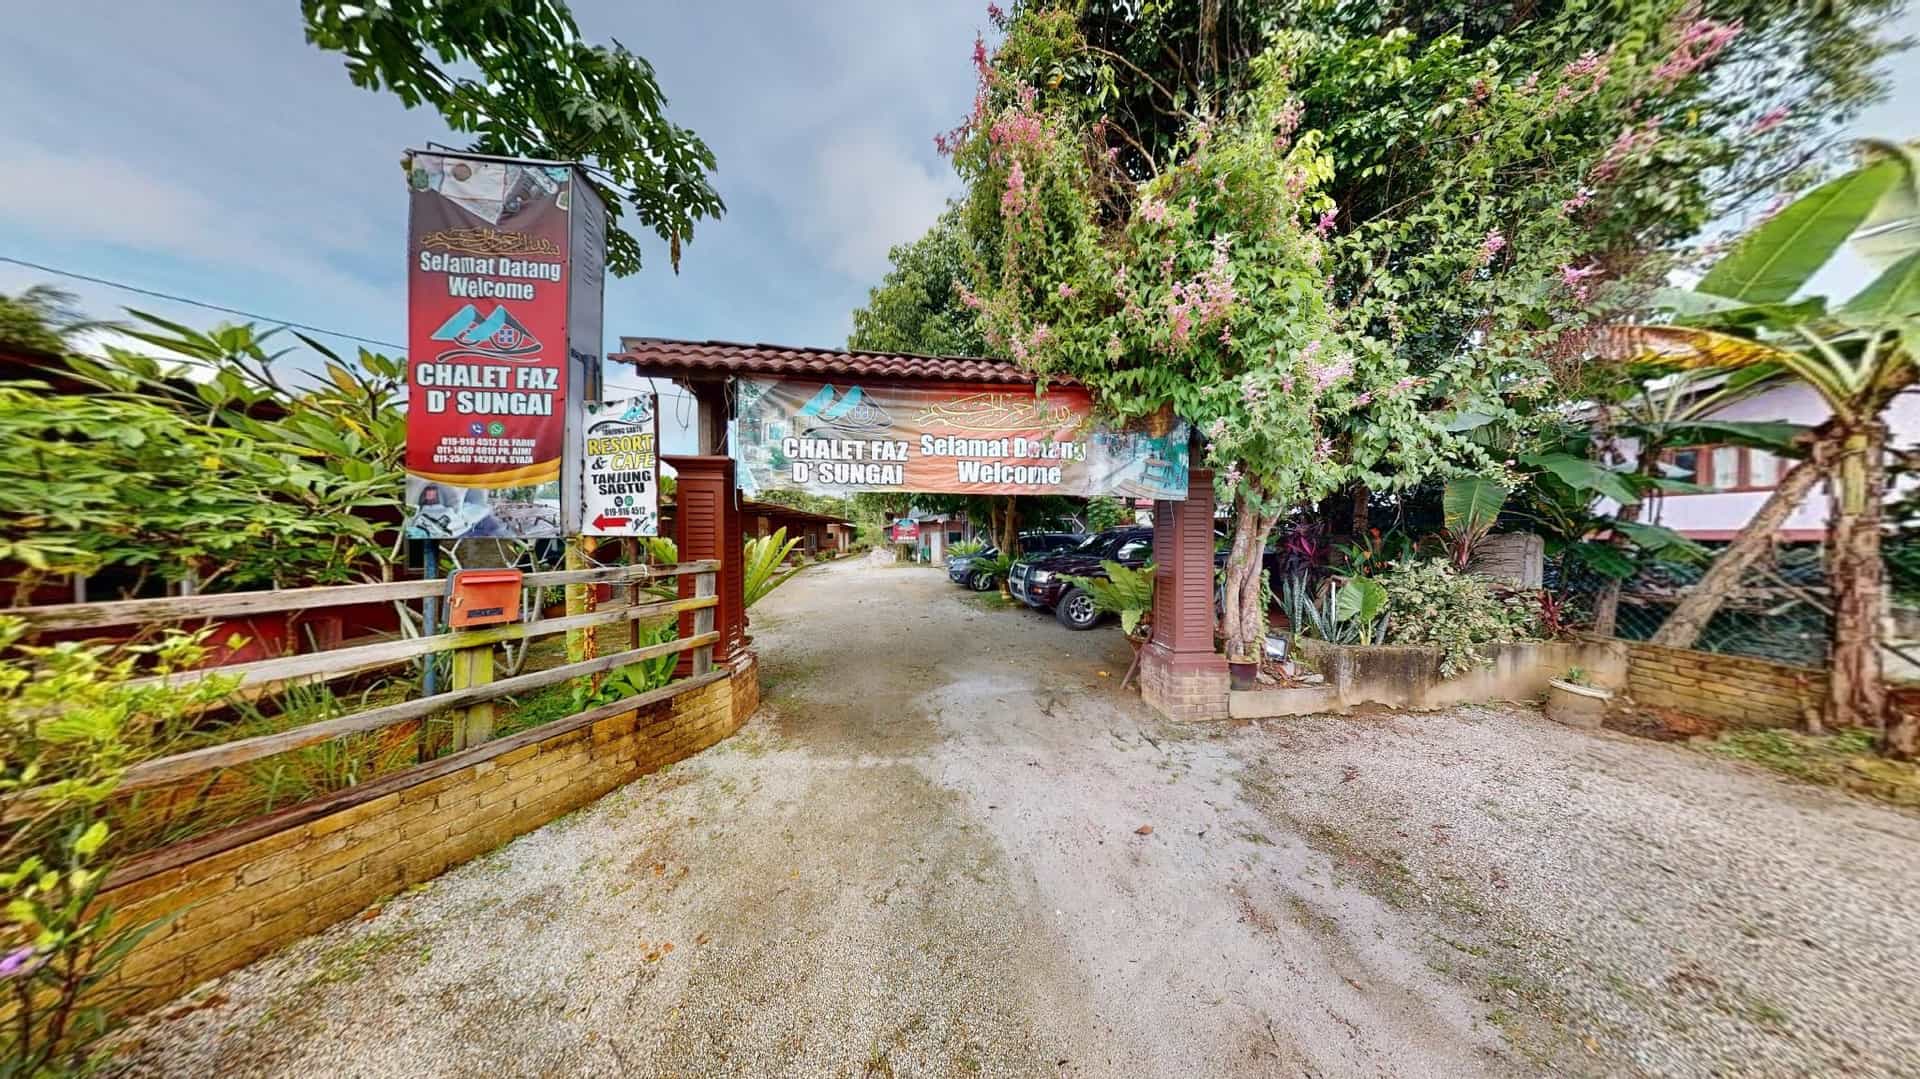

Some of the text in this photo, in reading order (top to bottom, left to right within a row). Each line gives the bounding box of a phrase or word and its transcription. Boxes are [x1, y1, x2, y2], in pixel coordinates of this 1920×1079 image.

[420, 251, 562, 282] Selamat Datang
[449, 276, 535, 300] Welcome
[416, 363, 560, 390] CHALET FAZ
[427, 390, 553, 416] D' SUNGAI
[587, 433, 654, 457] RESORT
[782, 437, 910, 462] CHALET FAZ
[920, 433, 1009, 457] Selamat
[591, 452, 656, 471] & CAFE
[957, 460, 1062, 485] Welcome
[591, 470, 652, 485] TANJUNG
[792, 462, 905, 486] D' SUNGAI
[598, 482, 645, 496] SABTU
